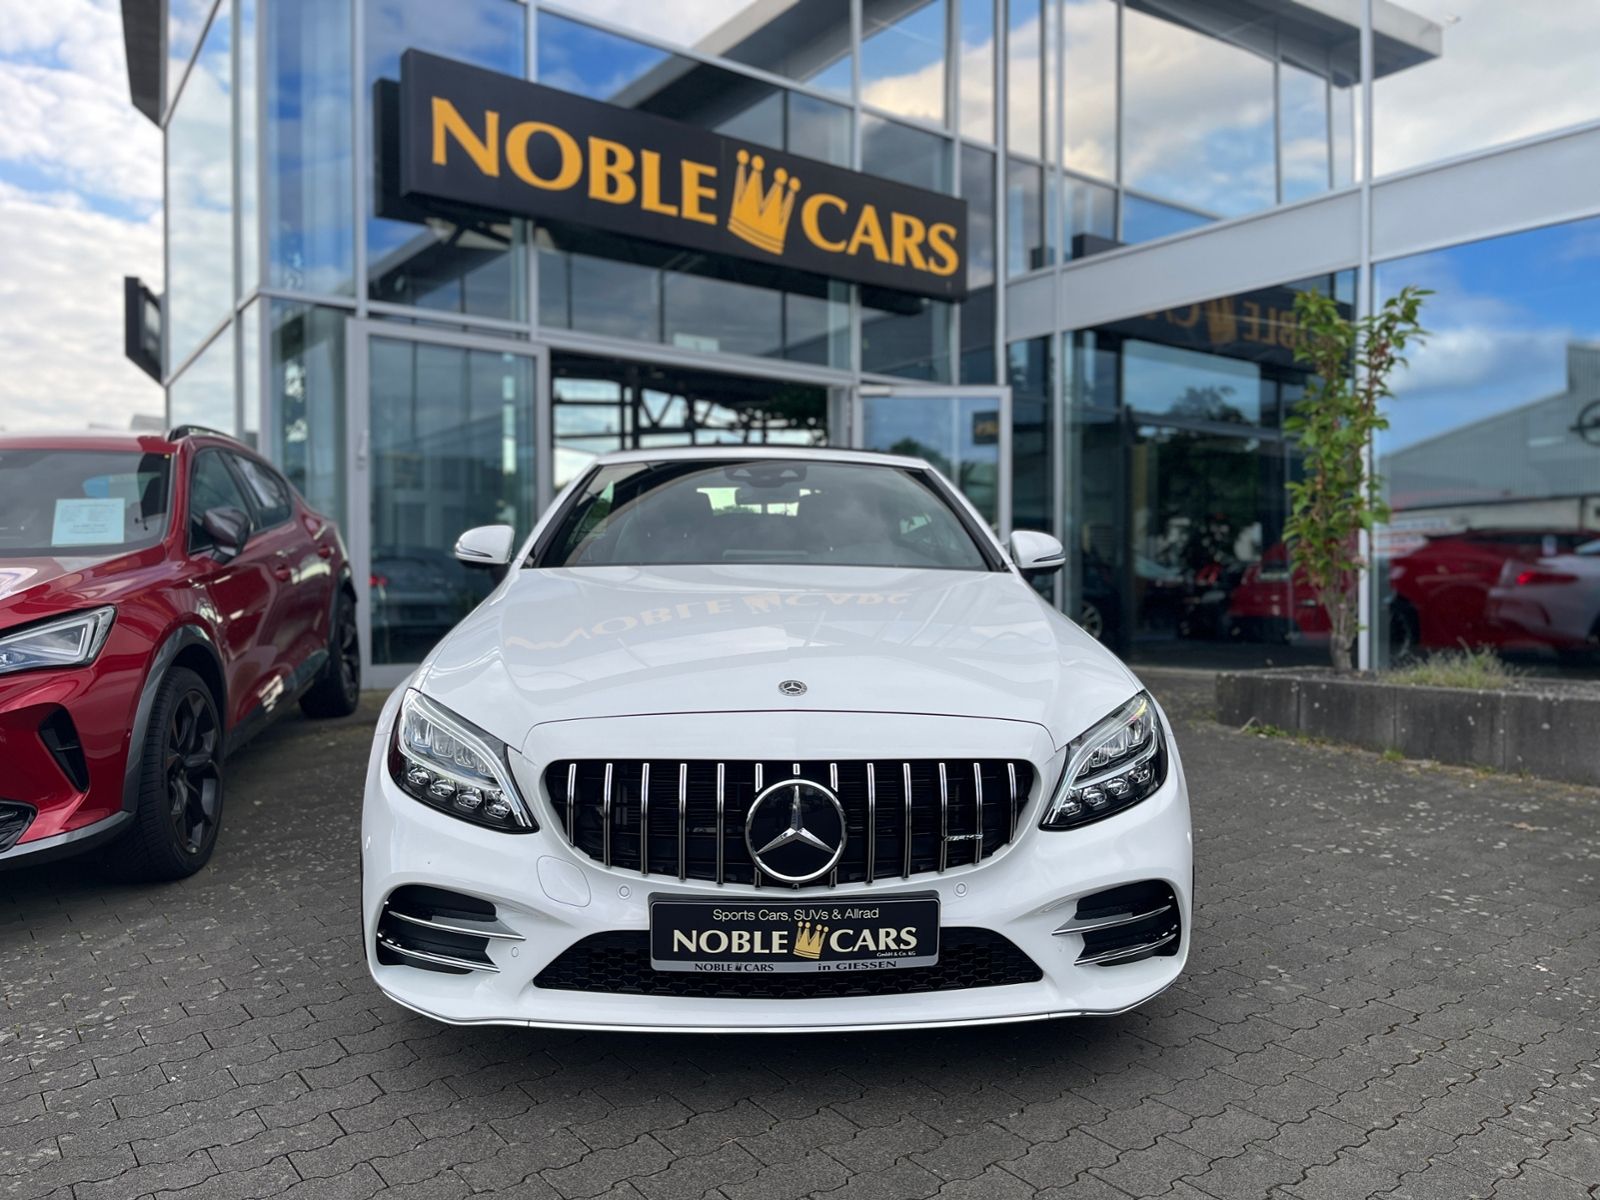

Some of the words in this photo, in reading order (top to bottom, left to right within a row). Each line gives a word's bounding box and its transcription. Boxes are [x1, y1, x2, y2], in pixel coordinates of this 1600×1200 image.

[431, 96, 717, 225] NOBLE
[801, 193, 959, 276] CARS
[712, 908, 756, 922] Sports
[758, 909, 792, 922] Cars,
[793, 908, 829, 921] SUVs
[831, 908, 842, 920] &
[844, 907, 880, 919] Allrad
[673, 929, 788, 954] NOBLE
[829, 926, 918, 953] CARS
[694, 962, 733, 972] NOBLE
[743, 963, 775, 972] CARS
[817, 963, 832, 971] in
[835, 960, 897, 971] GIESSEN
